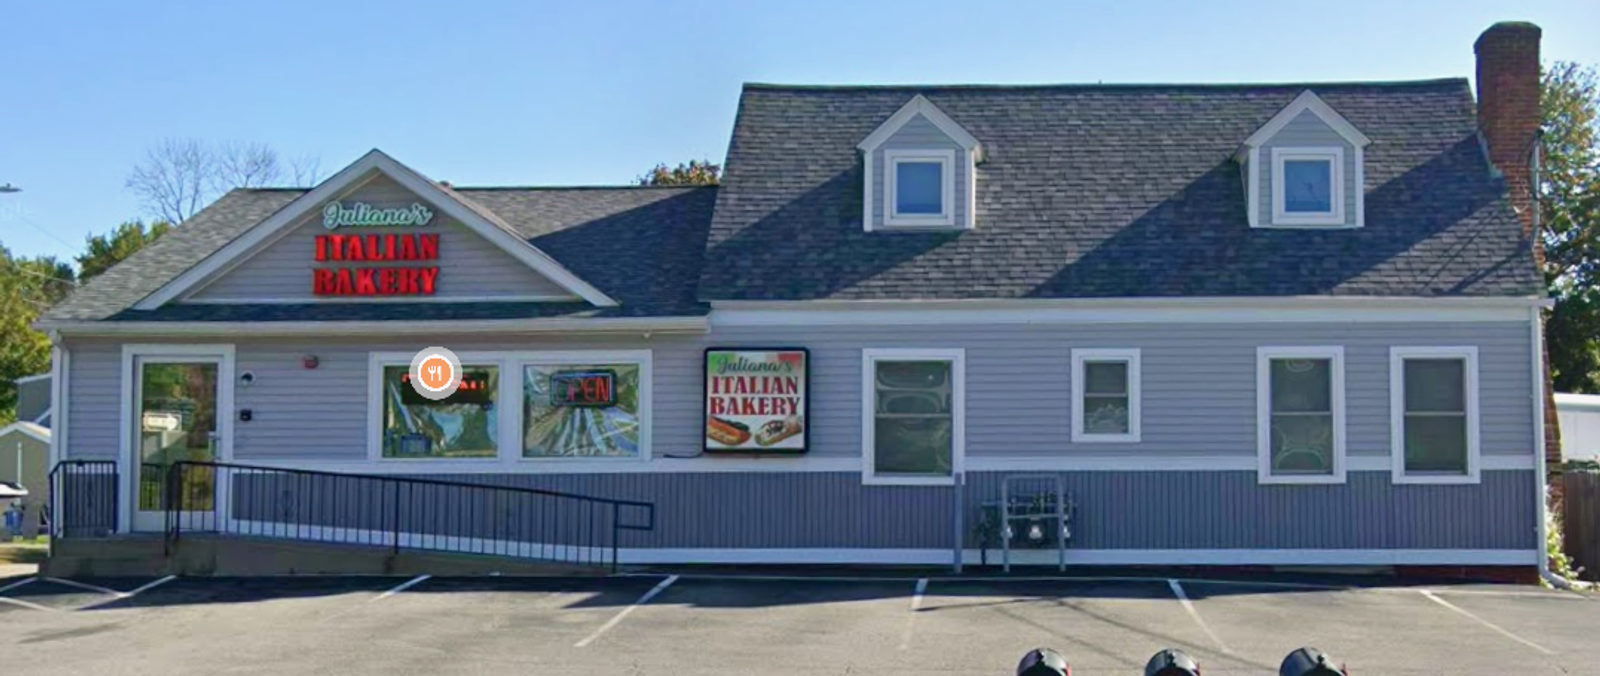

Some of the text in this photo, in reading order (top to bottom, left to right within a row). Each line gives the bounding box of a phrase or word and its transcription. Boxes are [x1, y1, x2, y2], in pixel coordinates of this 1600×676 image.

[323, 201, 433, 229] Juliana's
[314, 234, 439, 262] ITALIAN
[313, 267, 439, 296] BAKERY
[716, 355, 793, 374] Juliana's
[711, 375, 798, 395] ITALIAN
[710, 396, 800, 416] BAKERY
